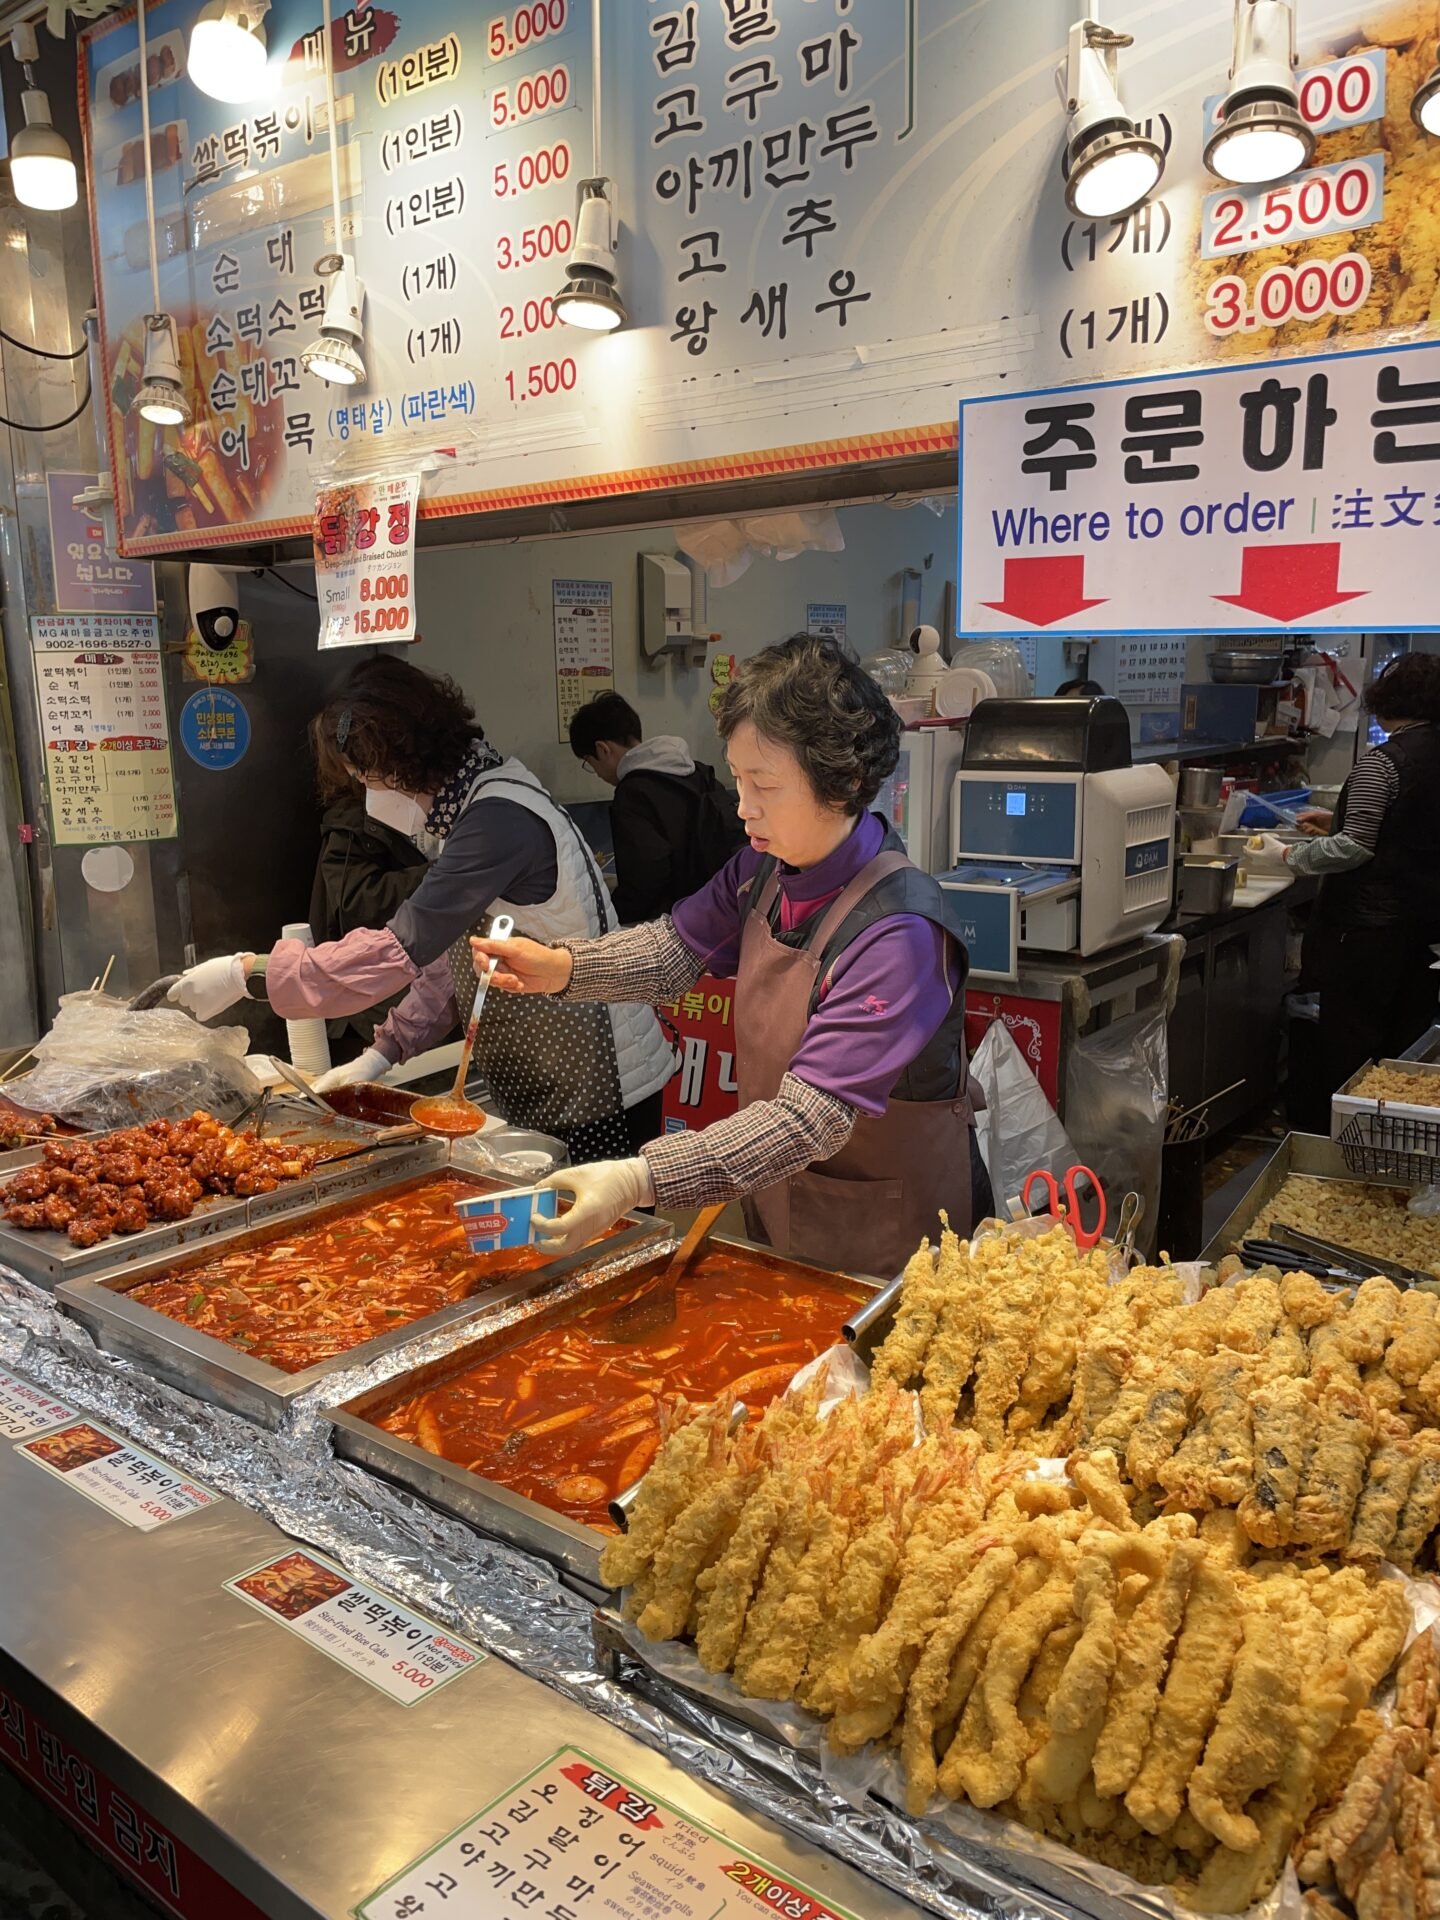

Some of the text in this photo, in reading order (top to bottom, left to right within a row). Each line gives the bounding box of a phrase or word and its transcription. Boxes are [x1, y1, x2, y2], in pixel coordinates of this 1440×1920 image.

[193, 0, 565, 183] 쌀떡볶이 (1인분) 5.000
[382, 109, 462, 171] (1인분)
[492, 68, 567, 127] 5.000
[655, 105, 878, 215] 야끼만두
[386, 177, 464, 236] (1인분)
[494, 144, 569, 197] 5.000
[1061, 168, 1369, 272] (1개) 2.500
[207, 219, 571, 354] 소떡소떡 (1개) 3.500
[1060, 259, 1364, 358] (1개) 3.000
[211, 296, 566, 412] 순대꼬 (1개) 2.00
[328, 397, 392, 441] (명태살)
[401, 380, 475, 427] (파란색)
[504, 357, 577, 401] 1.500
[320, 500, 410, 556] 닭강정
[992, 491, 1295, 548] Where to order
[1332, 484, 1440, 530] 注文
[362, 552, 385, 562] Braised
[386, 547, 408, 558] Chicken
[325, 585, 351, 604] Small
[360, 573, 409, 602] 8.000
[45, 640, 152, 649] 9002-1696-8527-0
[326, 614, 351, 631] Lge
[354, 605, 409, 634] 15.000
[107, 1451, 182, 1495] 쌀떡볶이
[139, 1500, 172, 1521] 5.000
[317, 1611, 390, 1659] Stir-fried Rice Cake
[337, 1591, 433, 1651] 쌀떡볶이
[392, 1659, 435, 1688] 5.000
[413, 1650, 449, 1674] (1인분)
[425, 1643, 465, 1669] Not spicy
[34, 1720, 100, 1827] 반입
[107, 1791, 181, 1900] 금지
[674, 1819, 710, 1845] fried
[627, 1870, 673, 1902] Seaweed
[670, 1898, 694, 1918] rolls
[726, 1860, 812, 1919] 2개이상
[735, 1888, 770, 1915] You can
